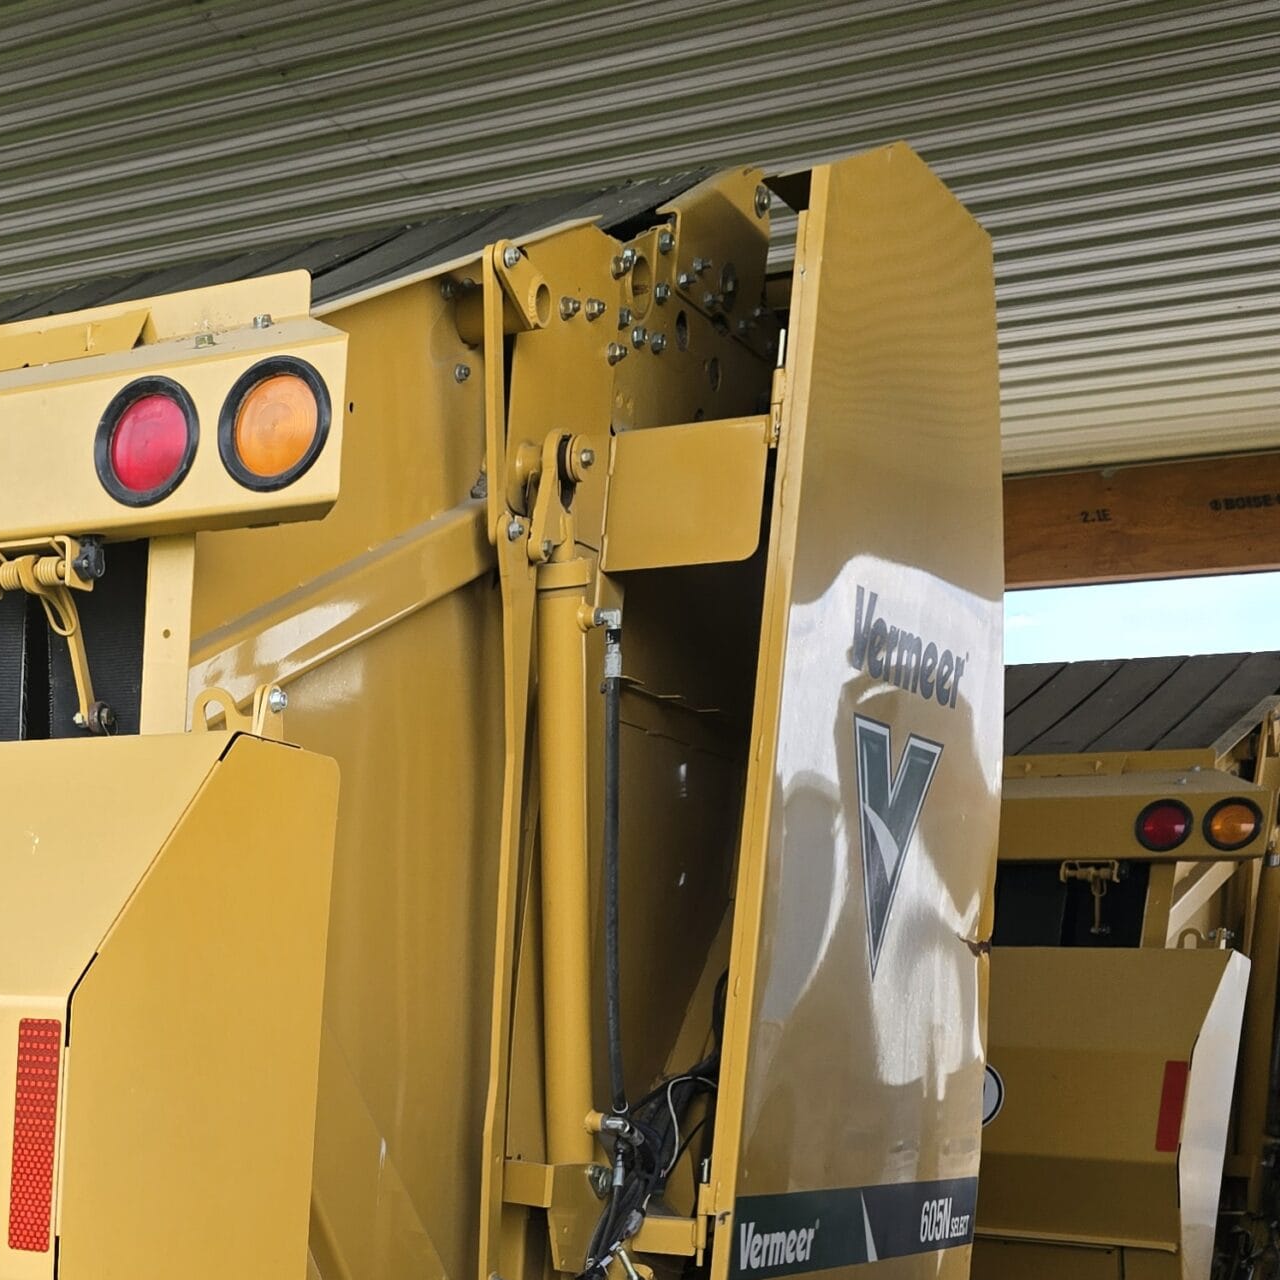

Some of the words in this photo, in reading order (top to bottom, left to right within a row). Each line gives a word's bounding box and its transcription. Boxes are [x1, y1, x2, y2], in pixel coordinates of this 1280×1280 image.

[851, 584, 967, 710] Vermeer
[739, 1220, 816, 1270] Vermeer
[920, 1197, 953, 1243] 605N
[950, 1214, 970, 1238] SELECT
